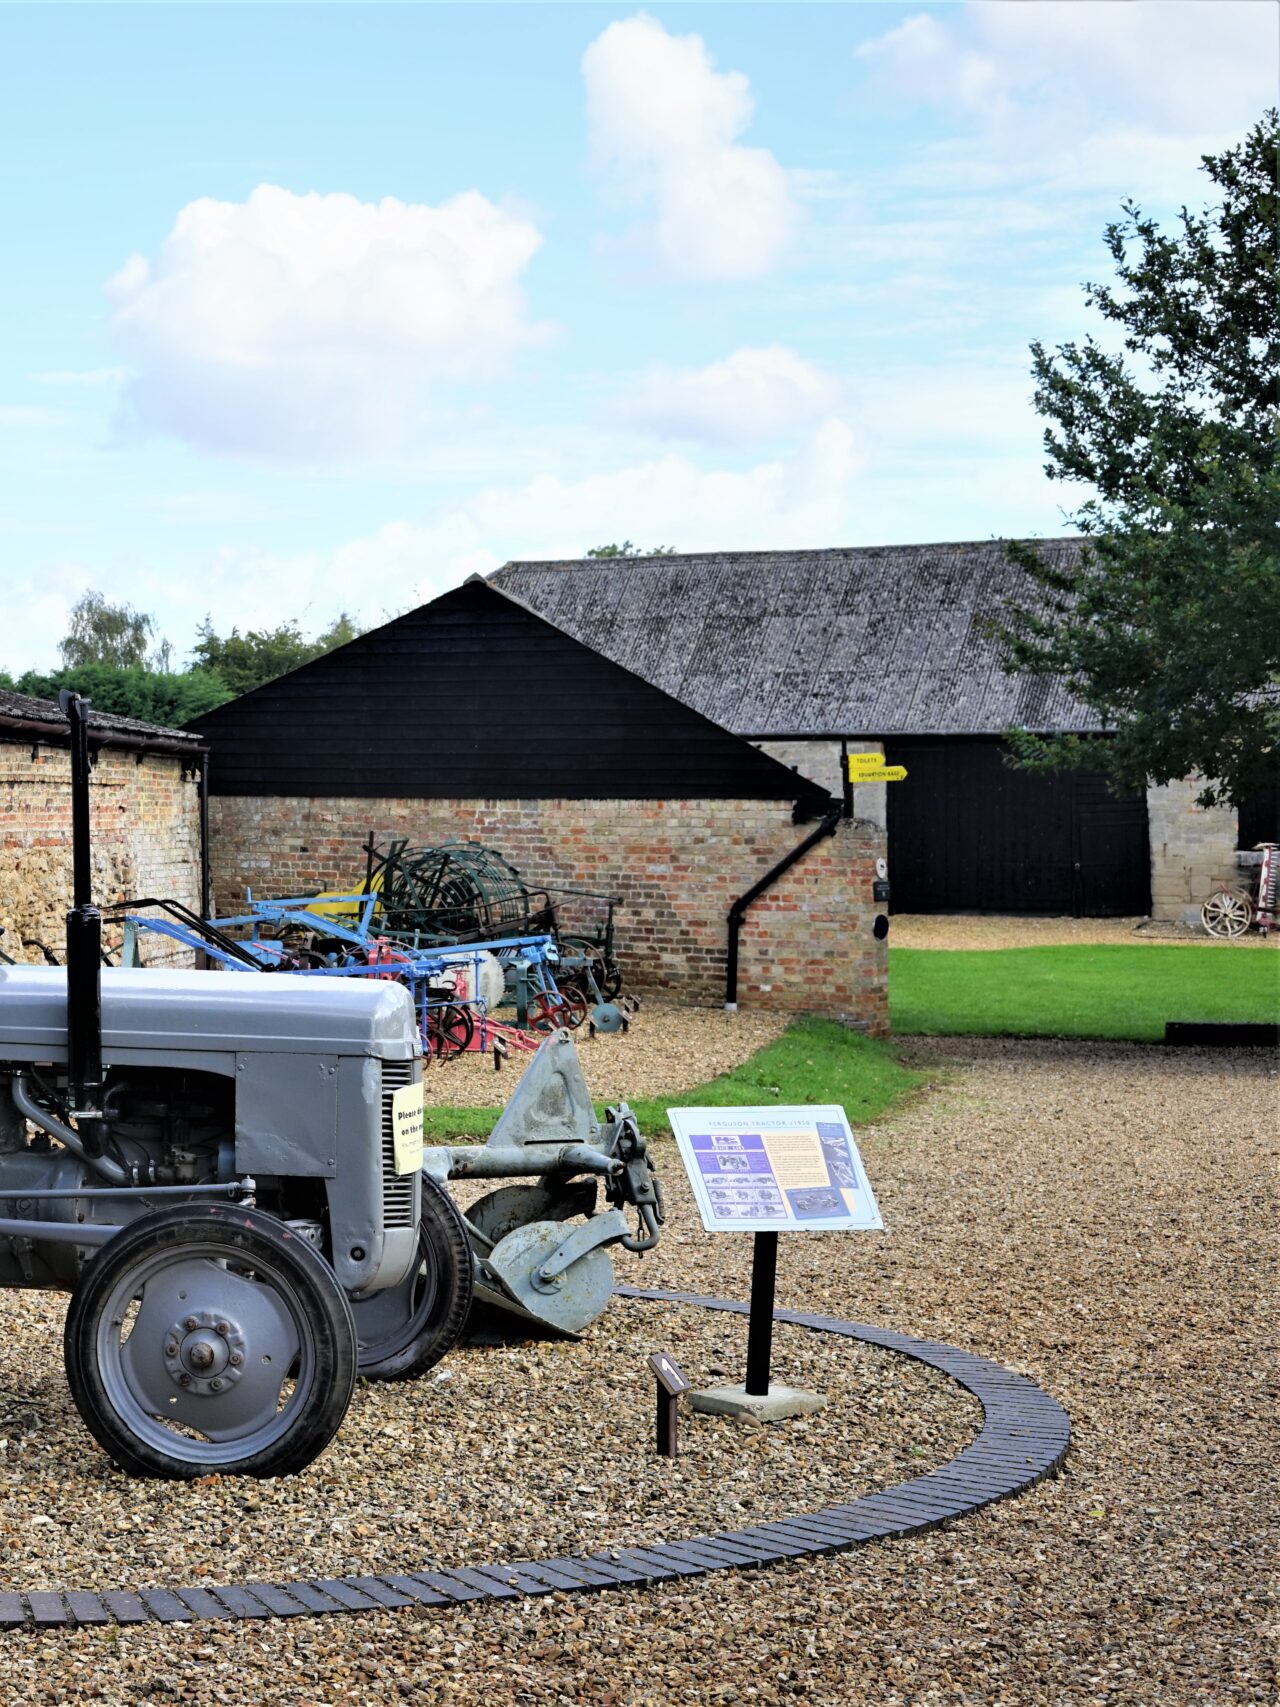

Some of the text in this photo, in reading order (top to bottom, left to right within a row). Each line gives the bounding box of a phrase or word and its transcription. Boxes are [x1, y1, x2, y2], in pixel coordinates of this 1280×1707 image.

[398, 1111, 416, 1120] Please
[401, 1128, 409, 1136] on
[410, 1124, 418, 1134] the
[661, 1357, 685, 1387] 1
